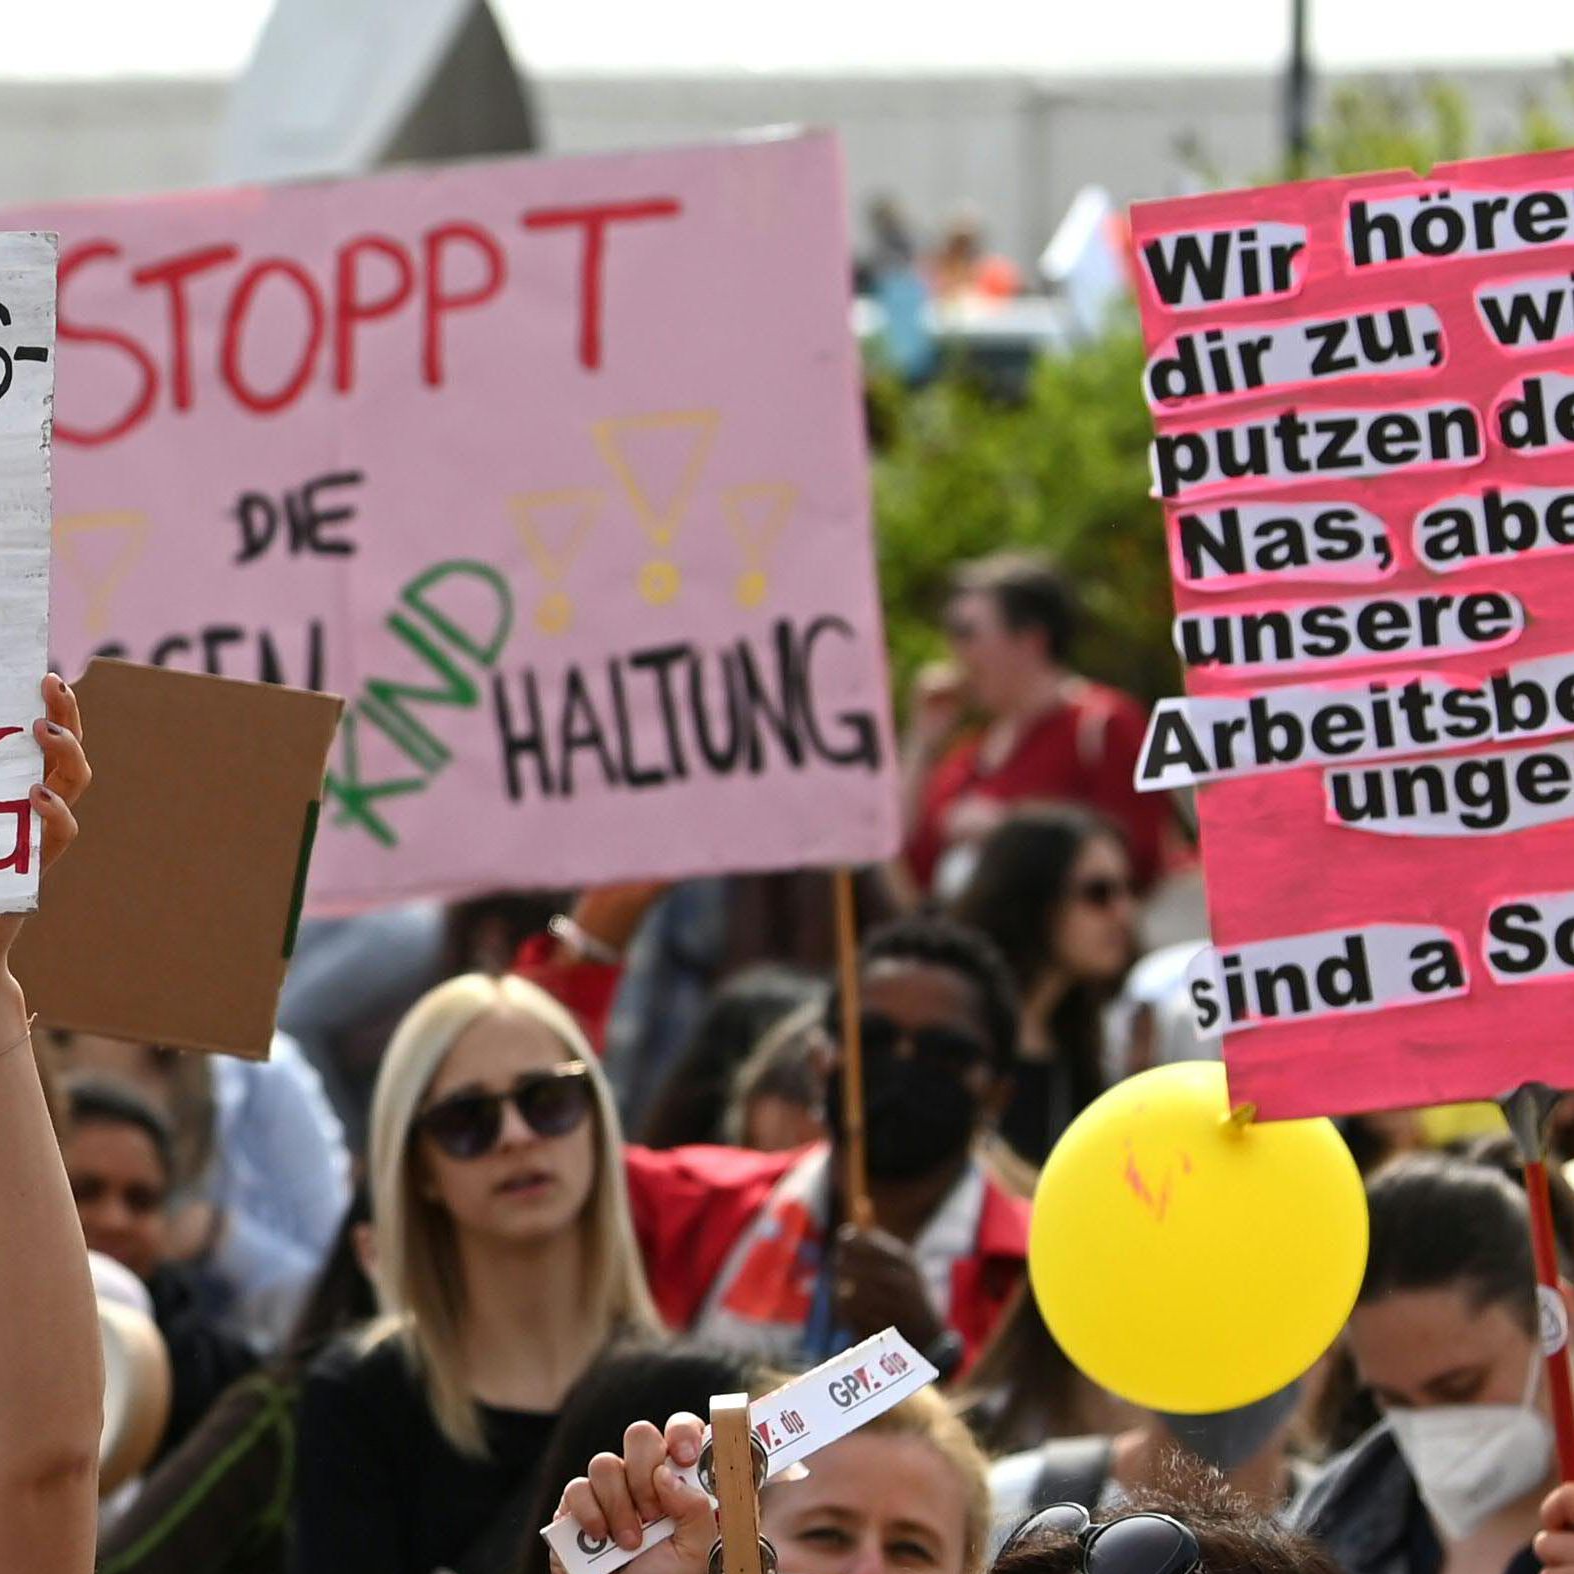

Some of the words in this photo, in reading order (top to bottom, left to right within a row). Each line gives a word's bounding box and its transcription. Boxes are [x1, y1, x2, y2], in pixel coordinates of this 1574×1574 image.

[1142, 229, 1306, 306] Wir
[1348, 189, 1568, 268] höre
[50, 197, 682, 448] STOPPT
[1149, 329, 1272, 406] dir
[1305, 306, 1443, 377] zu,
[1154, 407, 1481, 497] putzen
[232, 468, 366, 565] DIE
[1177, 506, 1395, 581] Nas,
[1180, 590, 1514, 668] unsere
[492, 616, 882, 804] HALTUNG
[1331, 752, 1572, 828] unge
[1189, 934, 1374, 1031] sind
[1408, 938, 1466, 994] a
